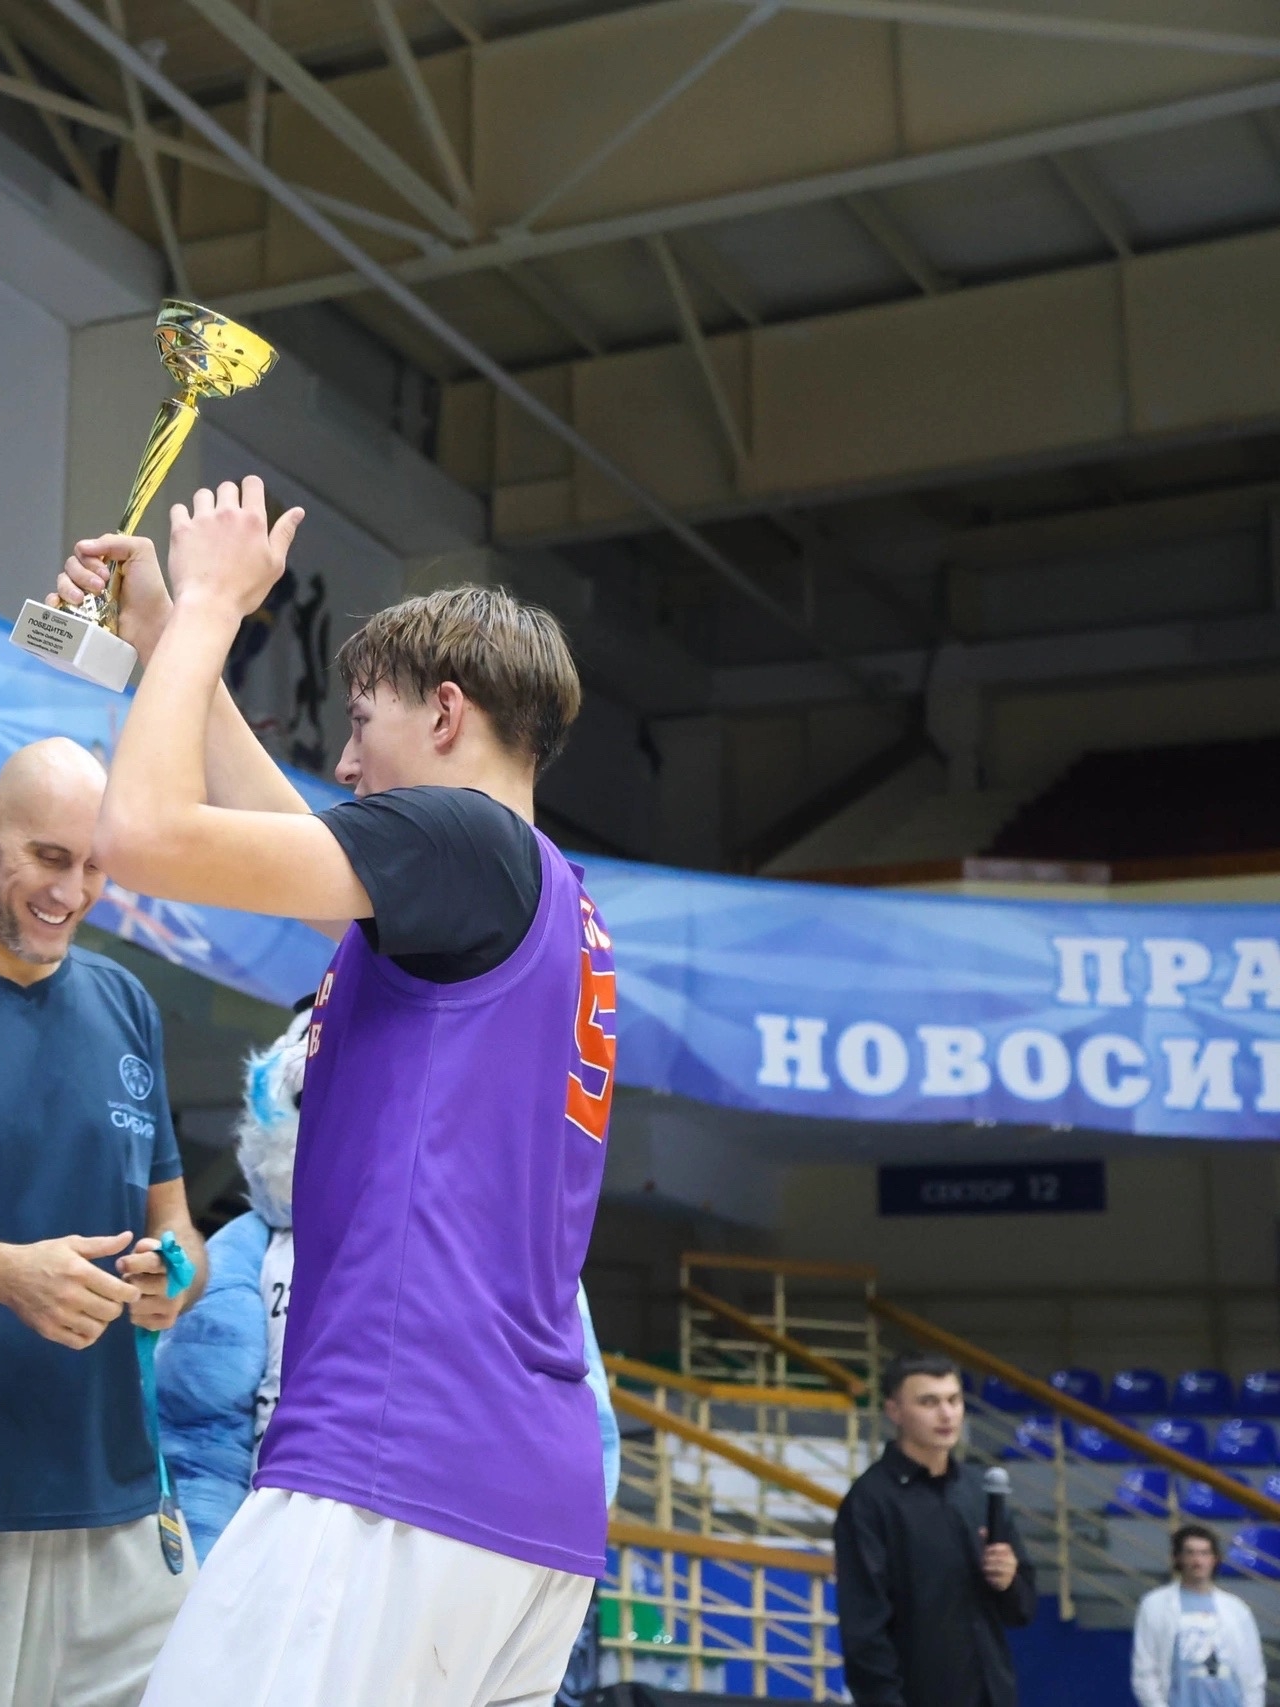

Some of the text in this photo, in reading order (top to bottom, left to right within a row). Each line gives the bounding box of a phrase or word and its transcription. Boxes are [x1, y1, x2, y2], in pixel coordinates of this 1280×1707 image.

[28, 617, 73, 639] ПОБЕДИТЕЛЬ
[1052, 936, 1280, 1009] ПРА
[1027, 1173, 1060, 1202] 12
